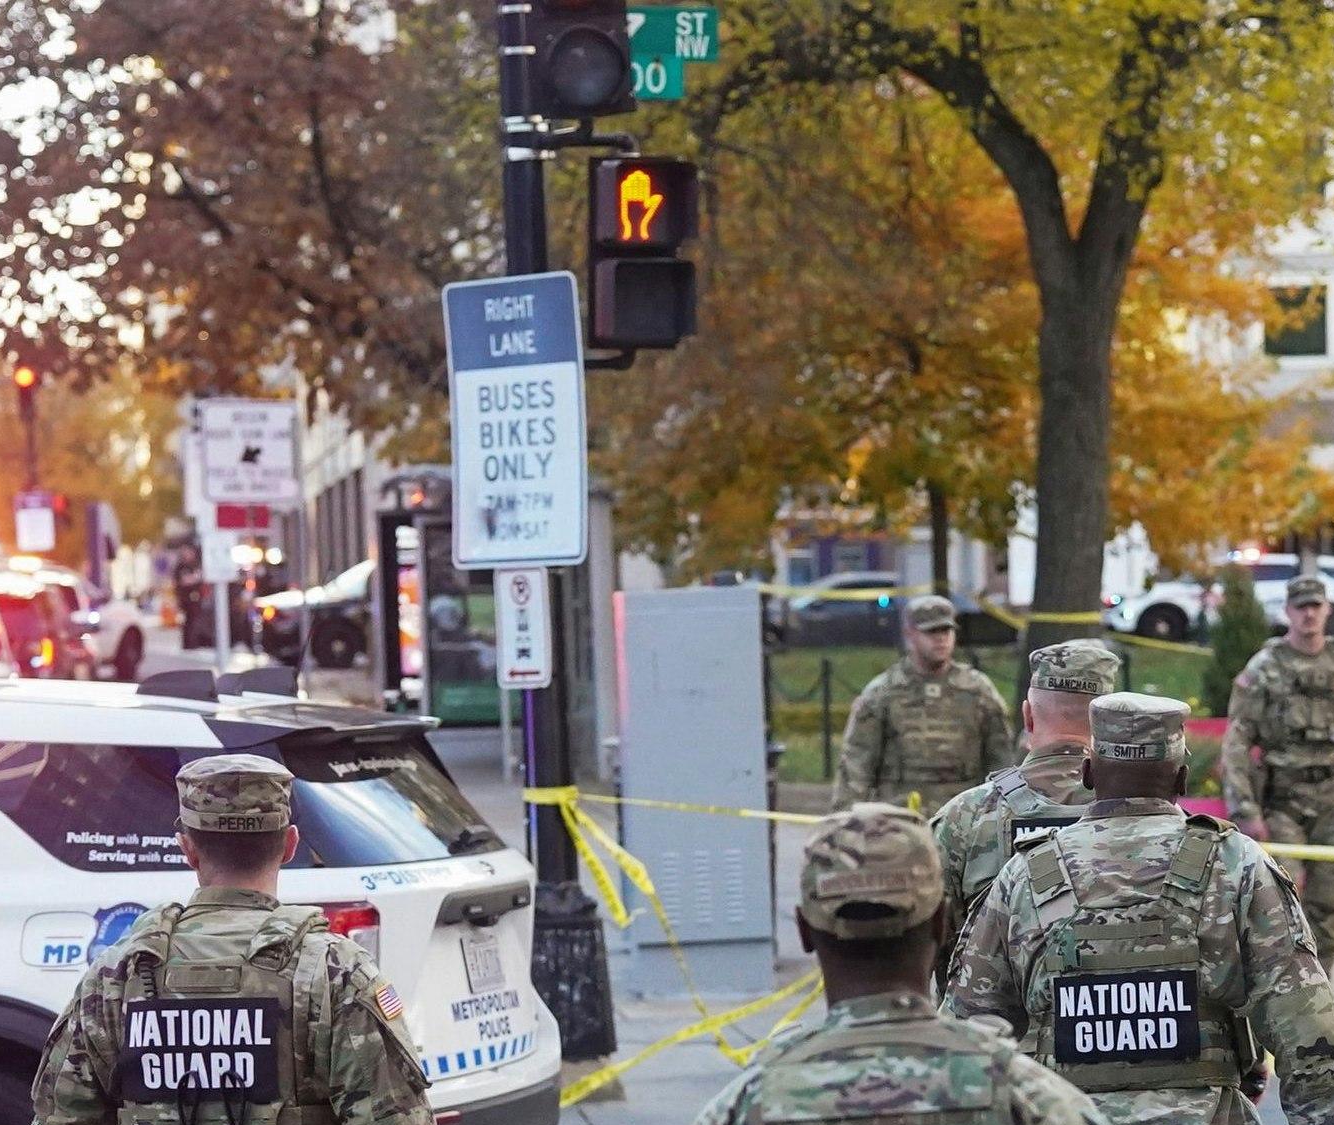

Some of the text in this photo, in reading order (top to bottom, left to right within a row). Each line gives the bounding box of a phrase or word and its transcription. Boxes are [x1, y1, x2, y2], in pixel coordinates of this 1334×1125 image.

[675, 11, 708, 35] ST
[675, 35, 710, 59] NW
[484, 294, 535, 322] RIGHT
[489, 329, 538, 357] LANE
[478, 380, 555, 413] BUSES
[480, 417, 556, 449] BIKES
[484, 452, 553, 481] ONLY
[1048, 677, 1098, 693] BLANCHARD
[1114, 744, 1146, 759] SMITH
[218, 816, 266, 831] PERRY
[66, 832, 115, 847] Policing
[117, 833, 139, 845] with
[88, 850, 136, 865] Serving
[138, 852, 161, 863] with
[42, 944, 82, 963] MP
[1059, 980, 1192, 1018] NATIONAL
[128, 1008, 272, 1048] NATIONAL
[478, 1015, 511, 1042] POLICE
[1074, 1017, 1178, 1053] GUARD
[140, 1051, 255, 1090] GUARD
